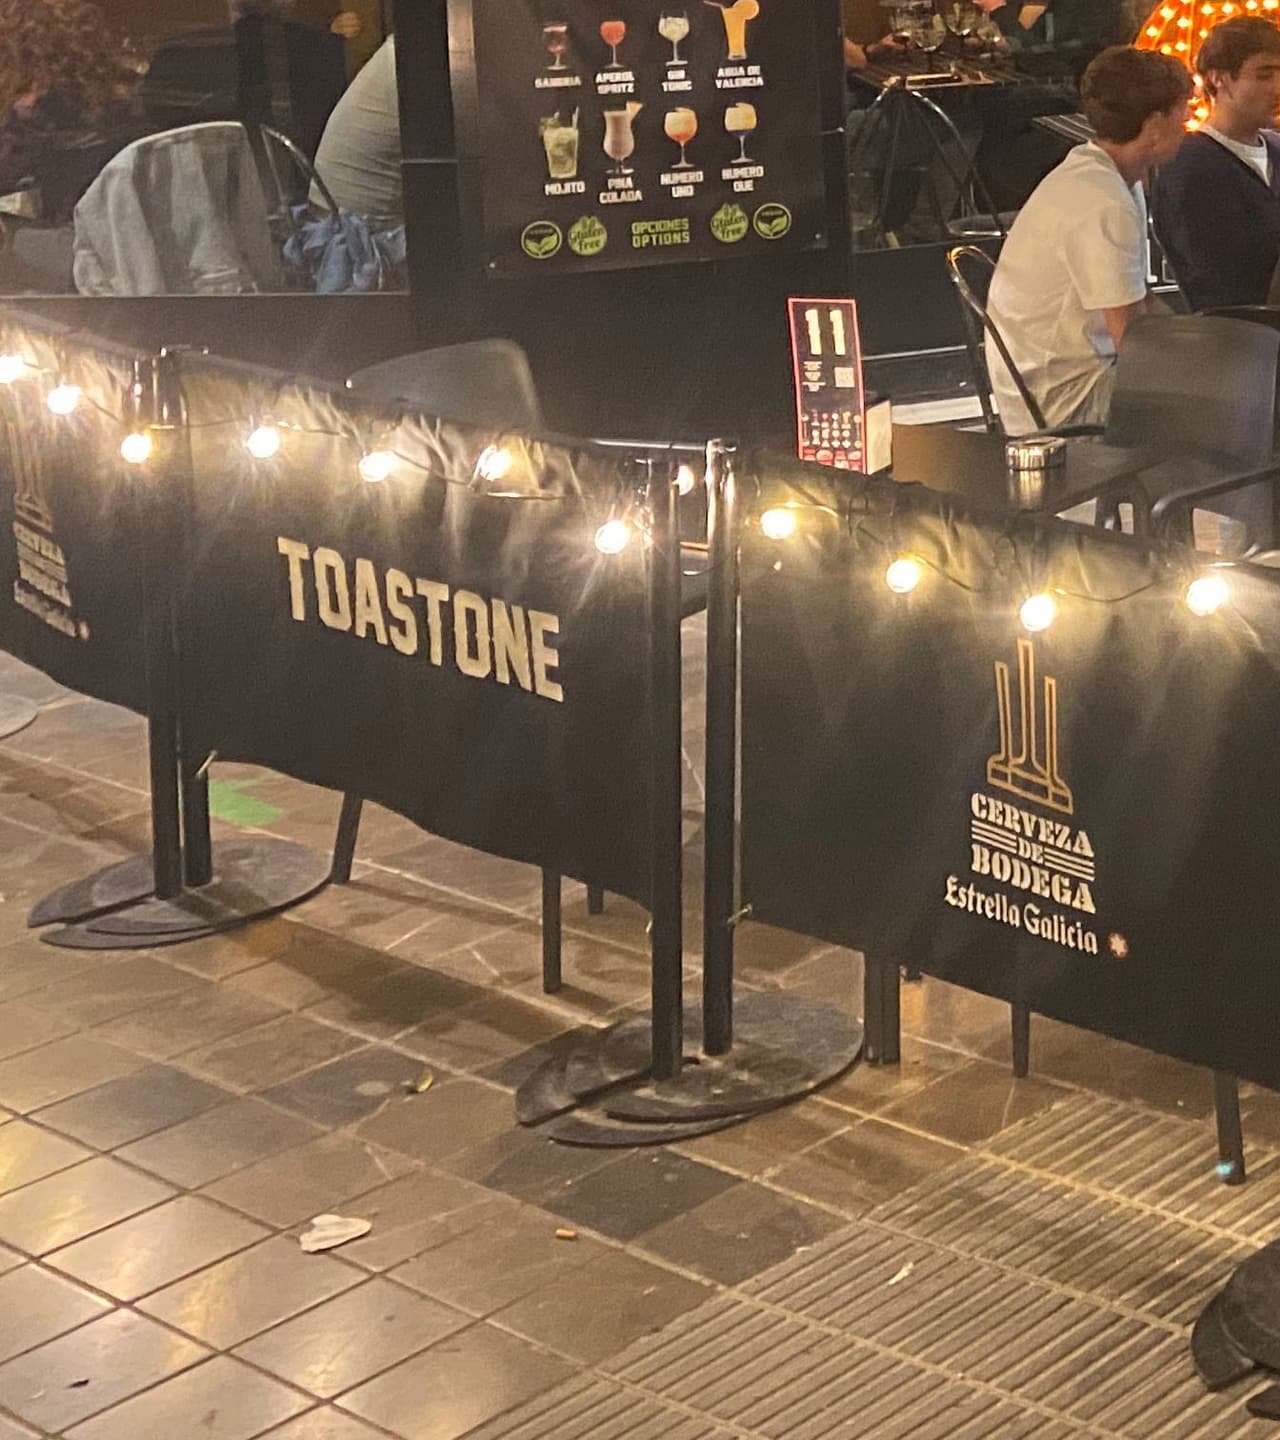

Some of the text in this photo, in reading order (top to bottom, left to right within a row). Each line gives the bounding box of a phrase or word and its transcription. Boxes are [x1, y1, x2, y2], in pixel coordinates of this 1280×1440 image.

[595, 71, 635, 83] APEROL
[715, 76, 764, 89] VALENCIA
[544, 181, 586, 195] MOJITO
[671, 184, 694, 198] UNO
[600, 190, 643, 204] COLADA
[631, 218, 689, 235] OPCIONES
[632, 231, 690, 248] OPTIONS
[805, 309, 846, 355] 11
[278, 536, 563, 703] TOASTONE
[971, 793, 1095, 858] CERVEZA
[1016, 837, 1045, 864] DE
[971, 843, 1096, 914] BODEGA
[944, 874, 1098, 955] Estrella Galicia
